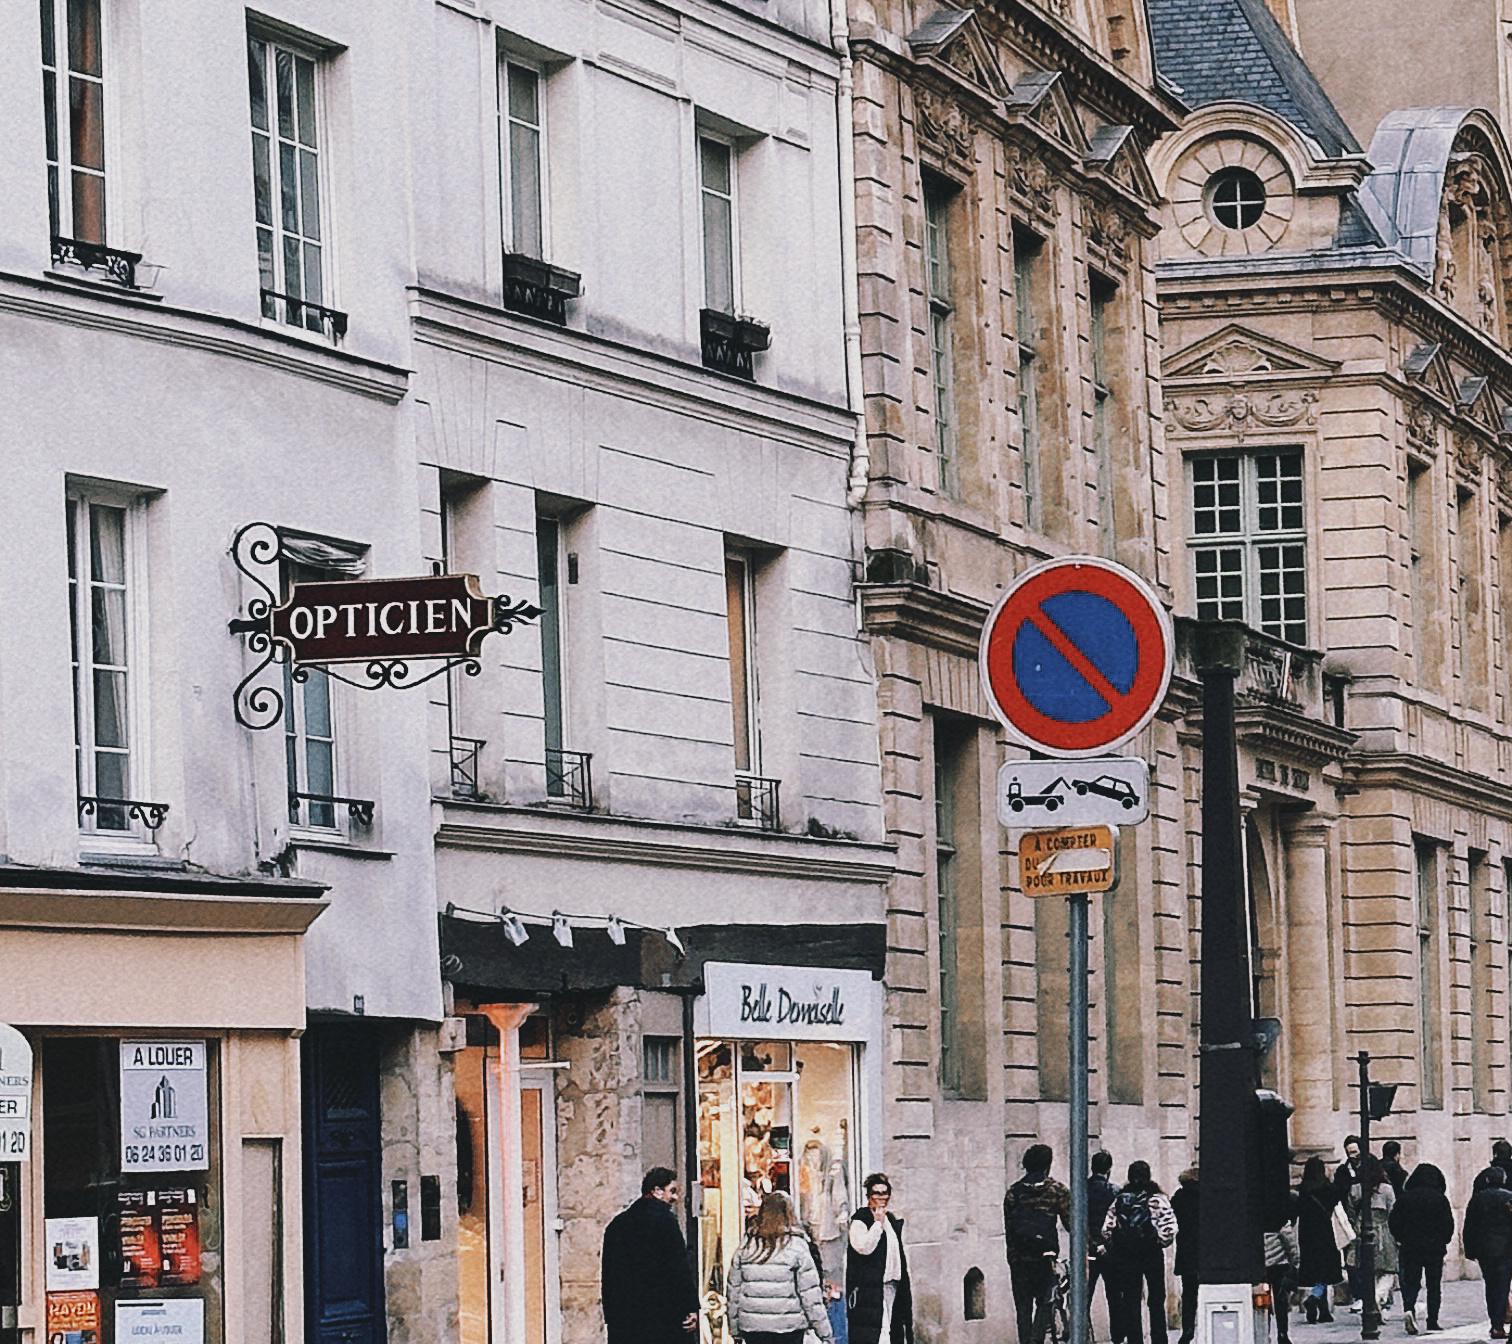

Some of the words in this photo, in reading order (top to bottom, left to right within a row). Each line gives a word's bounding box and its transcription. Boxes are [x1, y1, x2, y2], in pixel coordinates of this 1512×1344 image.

[289, 597, 472, 640] OPTICIEN
[1046, 834, 1096, 850] COMPTER
[1025, 857, 1039, 871] DU
[1026, 874, 1054, 888] POUR
[1060, 869, 1107, 886] TRAVAUX
[741, 983, 772, 1023] Belle
[133, 1047, 144, 1066] A
[148, 1047, 193, 1066] LOUER
[133, 1126, 146, 1138] SG
[149, 1125, 197, 1139] PARTNERS
[11, 1131, 25, 1154] 20
[125, 1146, 139, 1164] 06
[142, 1145, 155, 1163] 24
[158, 1145, 172, 1163] 36
[174, 1145, 187, 1162] 01
[190, 1144, 204, 1161] 20
